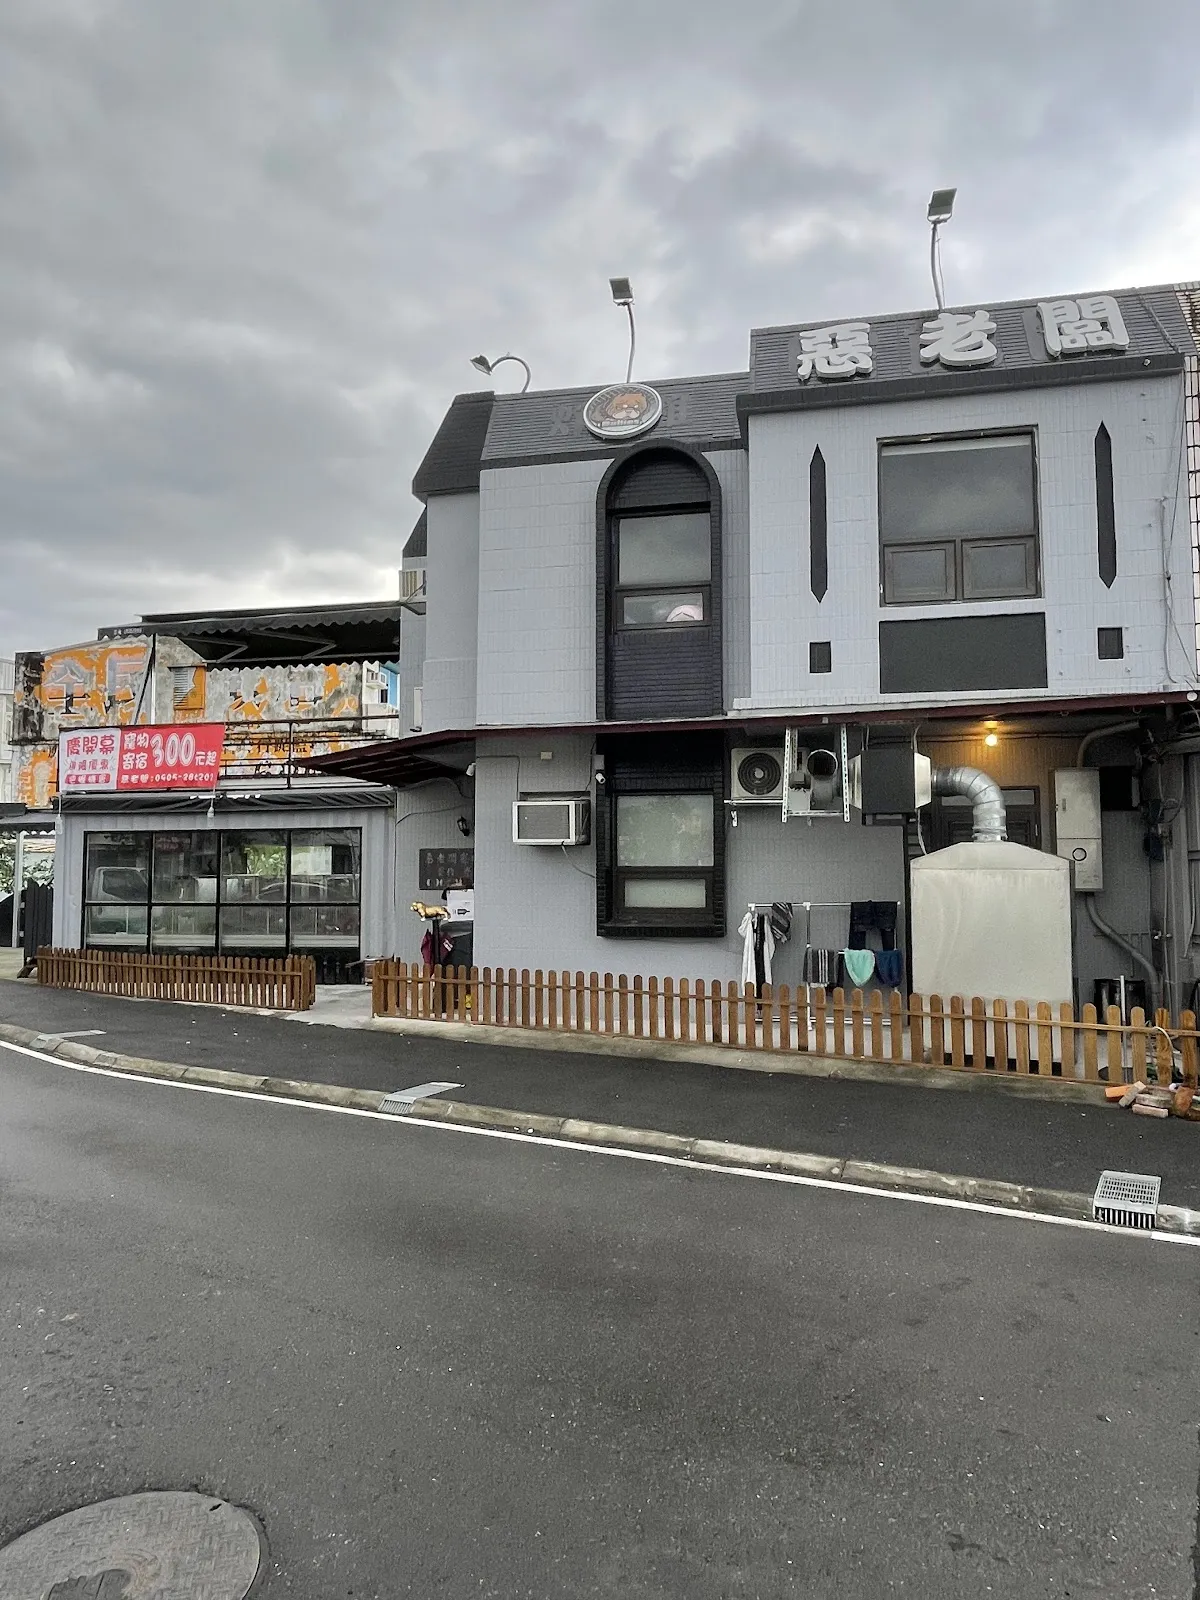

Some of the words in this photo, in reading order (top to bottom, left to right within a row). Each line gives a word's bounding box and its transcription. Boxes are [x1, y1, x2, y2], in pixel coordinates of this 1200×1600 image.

[798, 296, 1131, 381] 惡老闆
[66, 734, 115, 757] 慶開幕
[123, 732, 149, 750] 寵物
[122, 752, 148, 770] 寄宿
